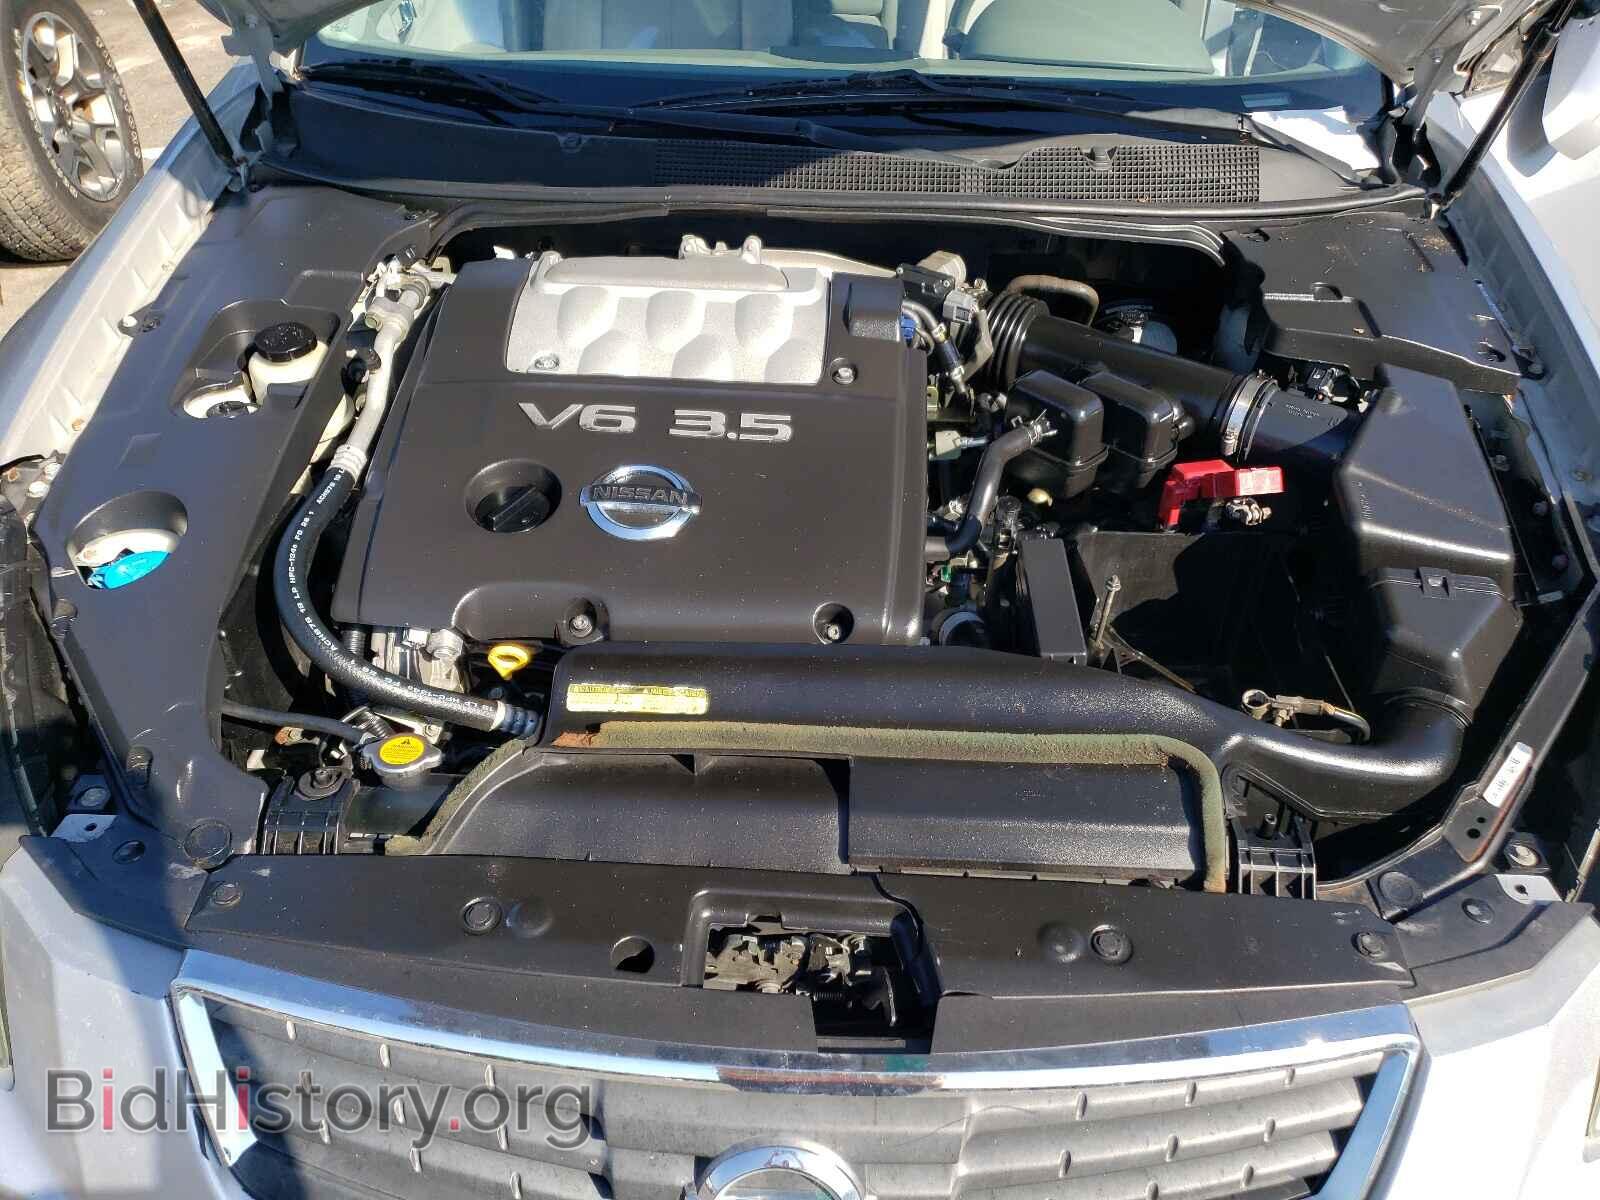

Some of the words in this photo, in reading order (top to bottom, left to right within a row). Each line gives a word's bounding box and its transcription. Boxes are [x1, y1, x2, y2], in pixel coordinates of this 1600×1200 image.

[518, 402, 636, 433] V6
[669, 409, 792, 442] 3.5
[592, 485, 689, 505] NISSAN
